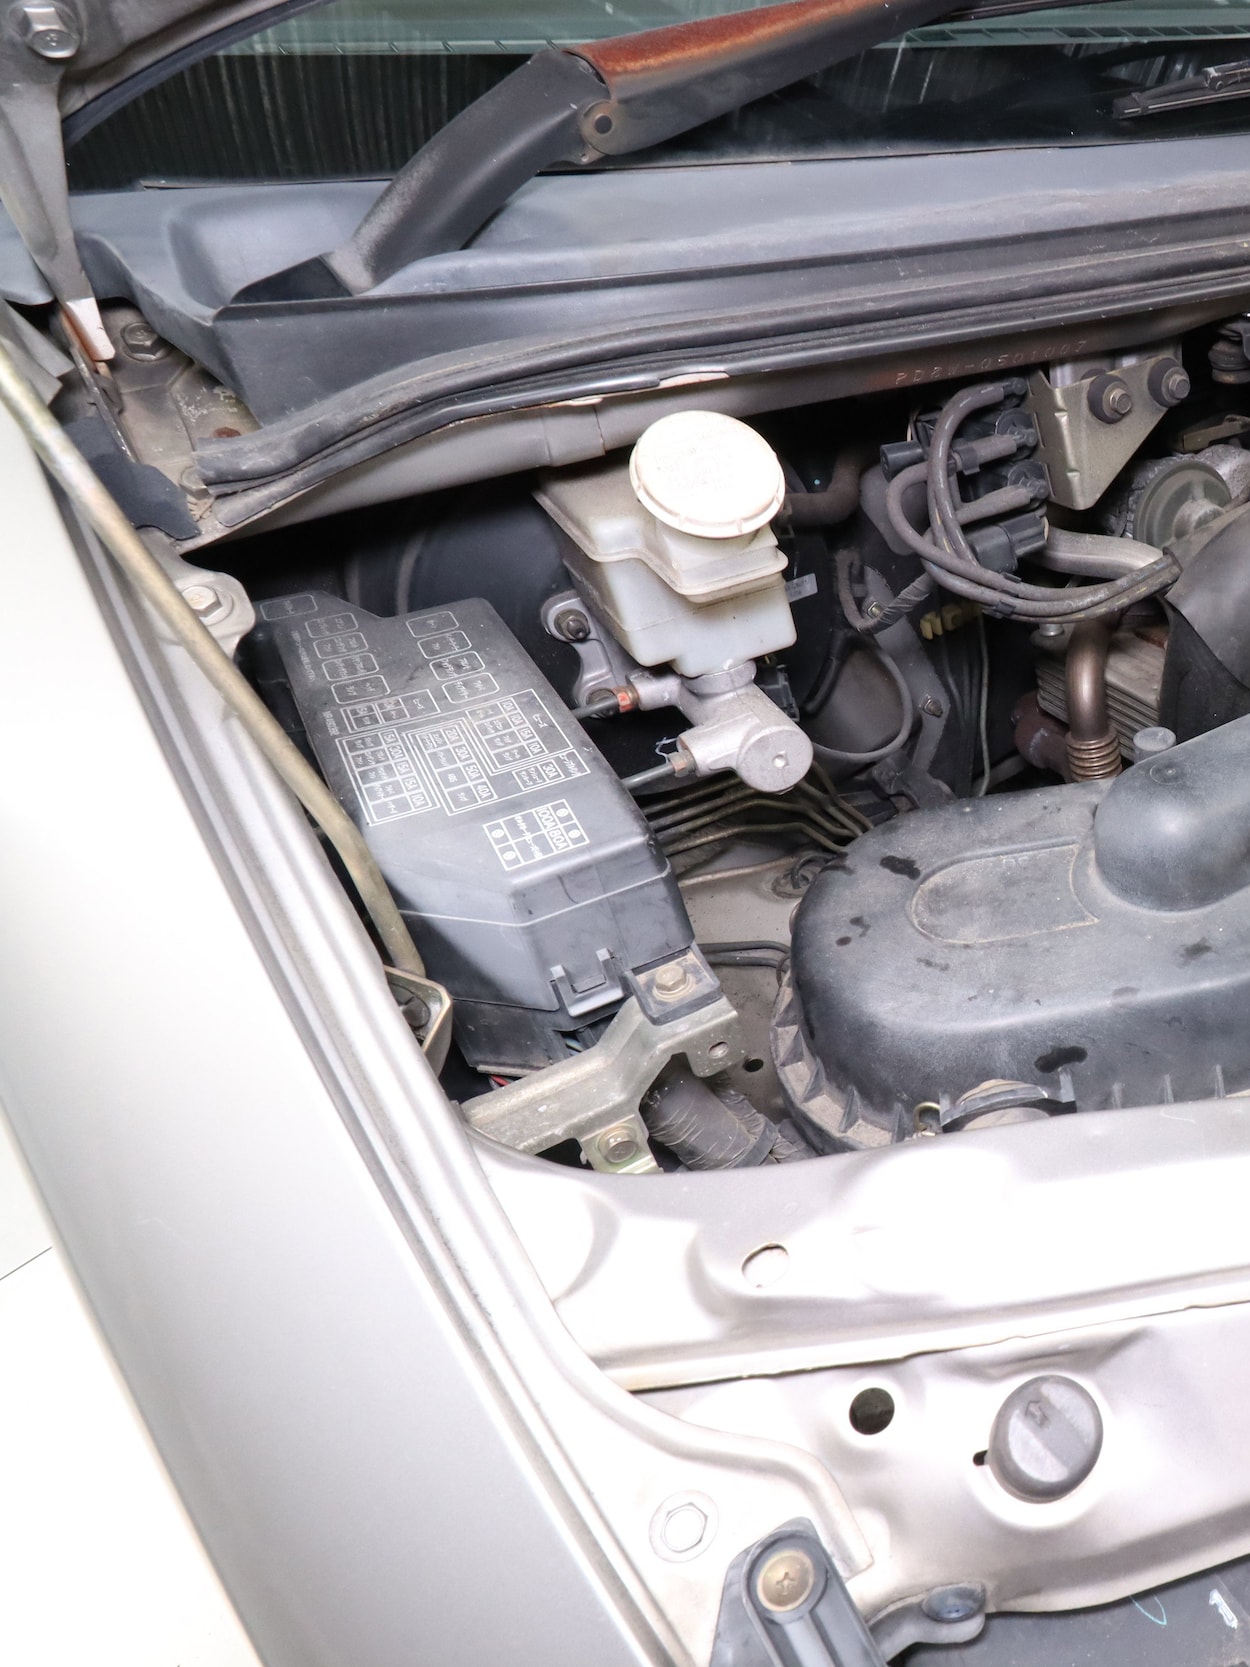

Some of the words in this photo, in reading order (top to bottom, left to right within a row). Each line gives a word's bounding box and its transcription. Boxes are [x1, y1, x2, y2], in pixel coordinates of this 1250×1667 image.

[519, 728, 533, 740] 15A
[456, 746, 470, 761] 30A
[528, 741, 543, 754] 10A
[396, 761, 411, 774] 15A
[465, 764, 481, 779] 50A
[542, 764, 558, 778] 30A
[404, 779, 418, 791] 15A
[477, 784, 492, 799] 40A
[411, 793, 426, 807] 10A
[536, 805, 557, 830] 100A
[548, 829, 569, 850] 80A
